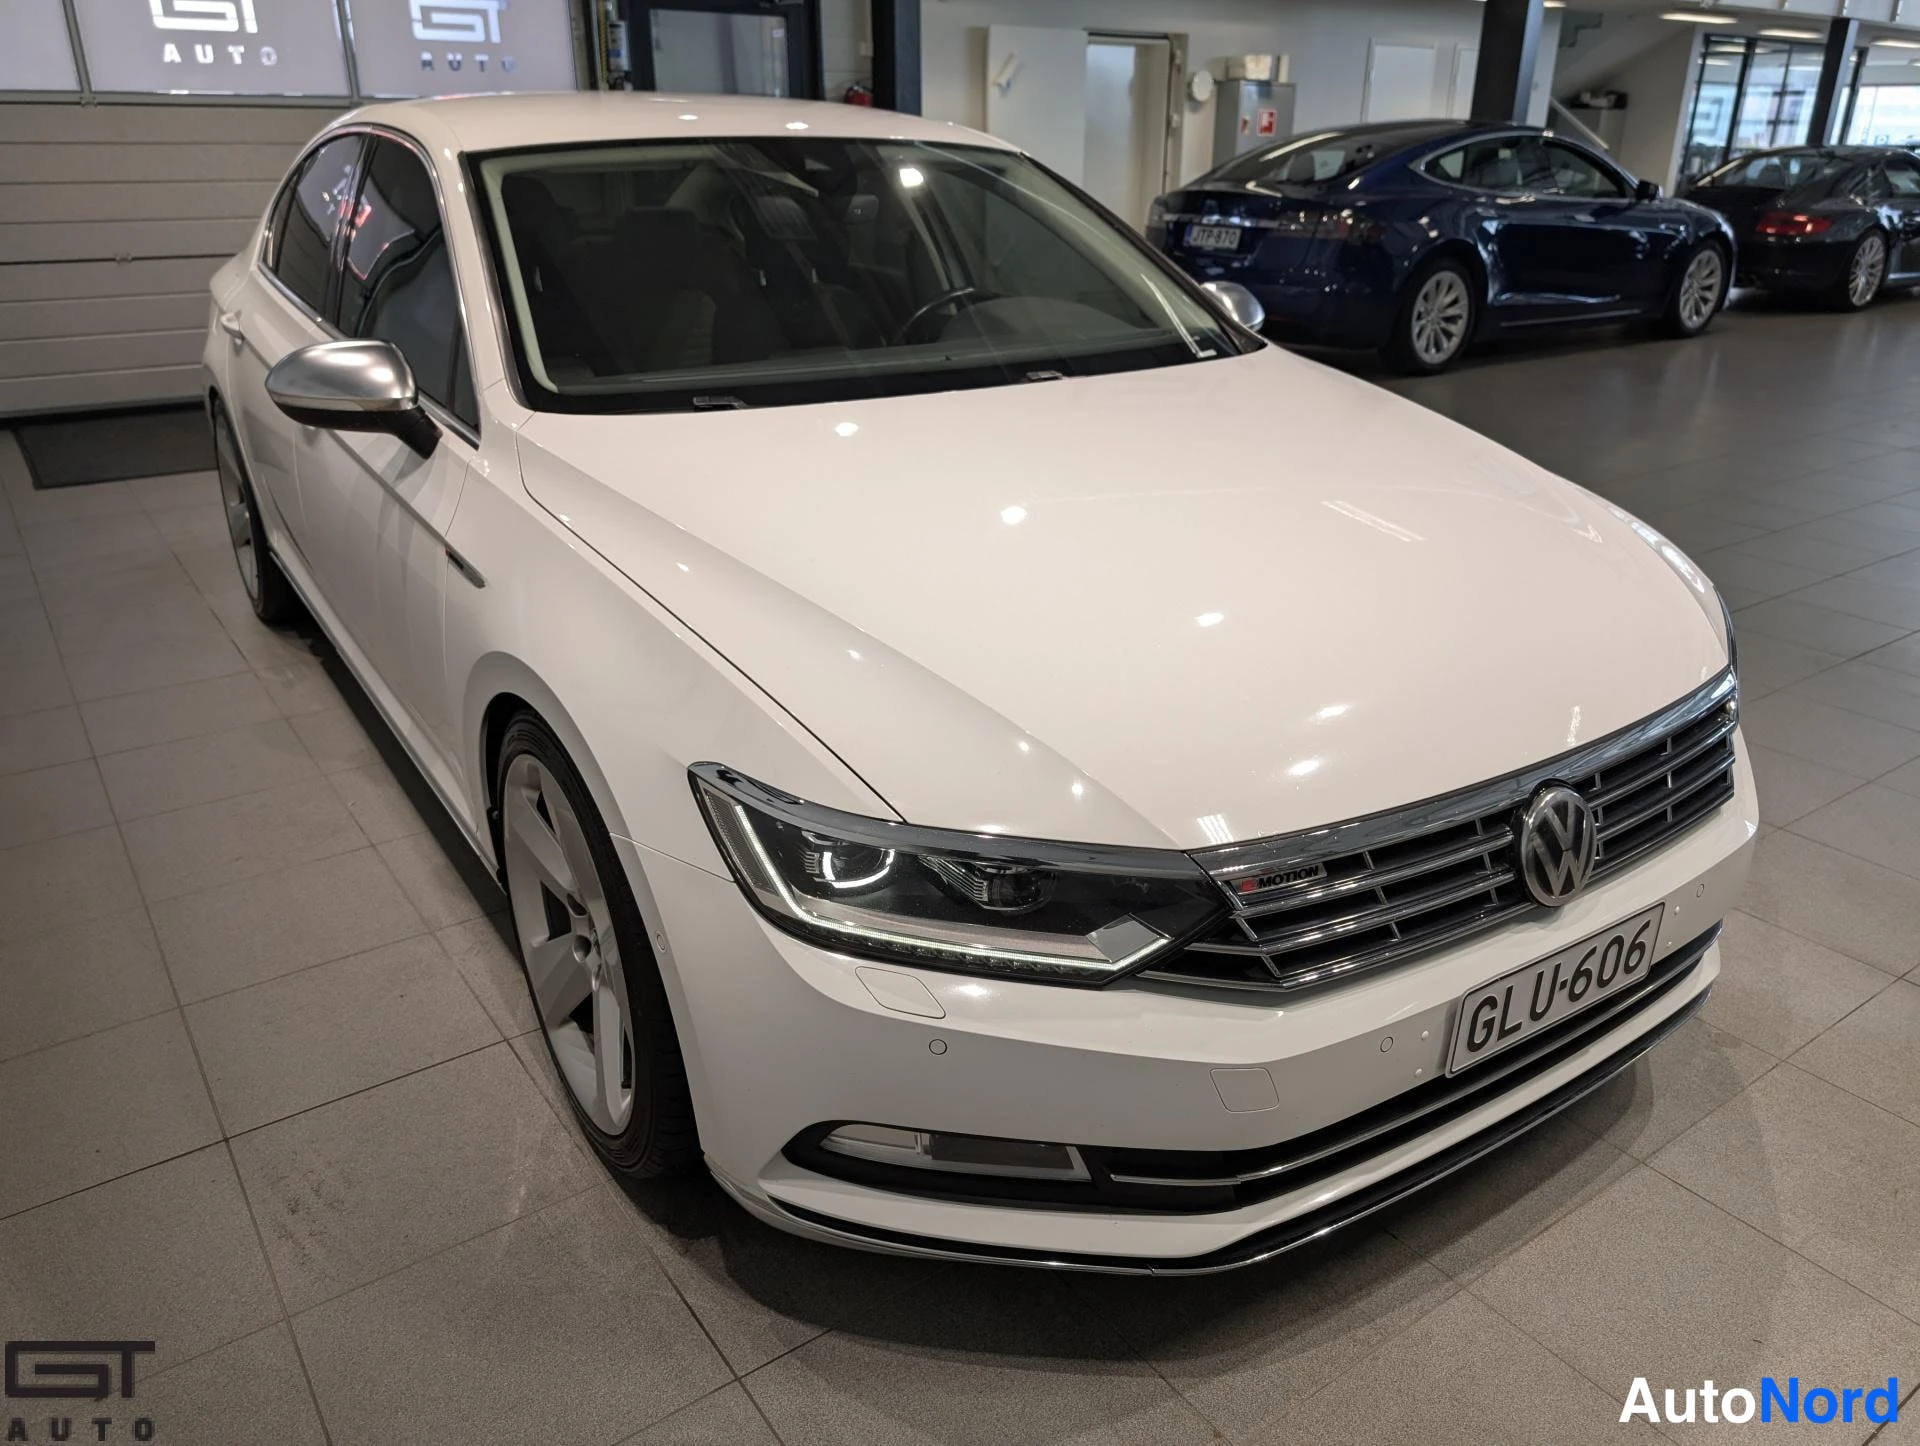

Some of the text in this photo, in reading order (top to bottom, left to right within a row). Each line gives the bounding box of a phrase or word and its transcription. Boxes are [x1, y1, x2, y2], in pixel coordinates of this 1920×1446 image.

[163, 43, 278, 66] AUTO
[420, 51, 517, 73] AUTO
[1527, 793, 1594, 903] VW
[1466, 919, 1651, 1053] GLU-606
